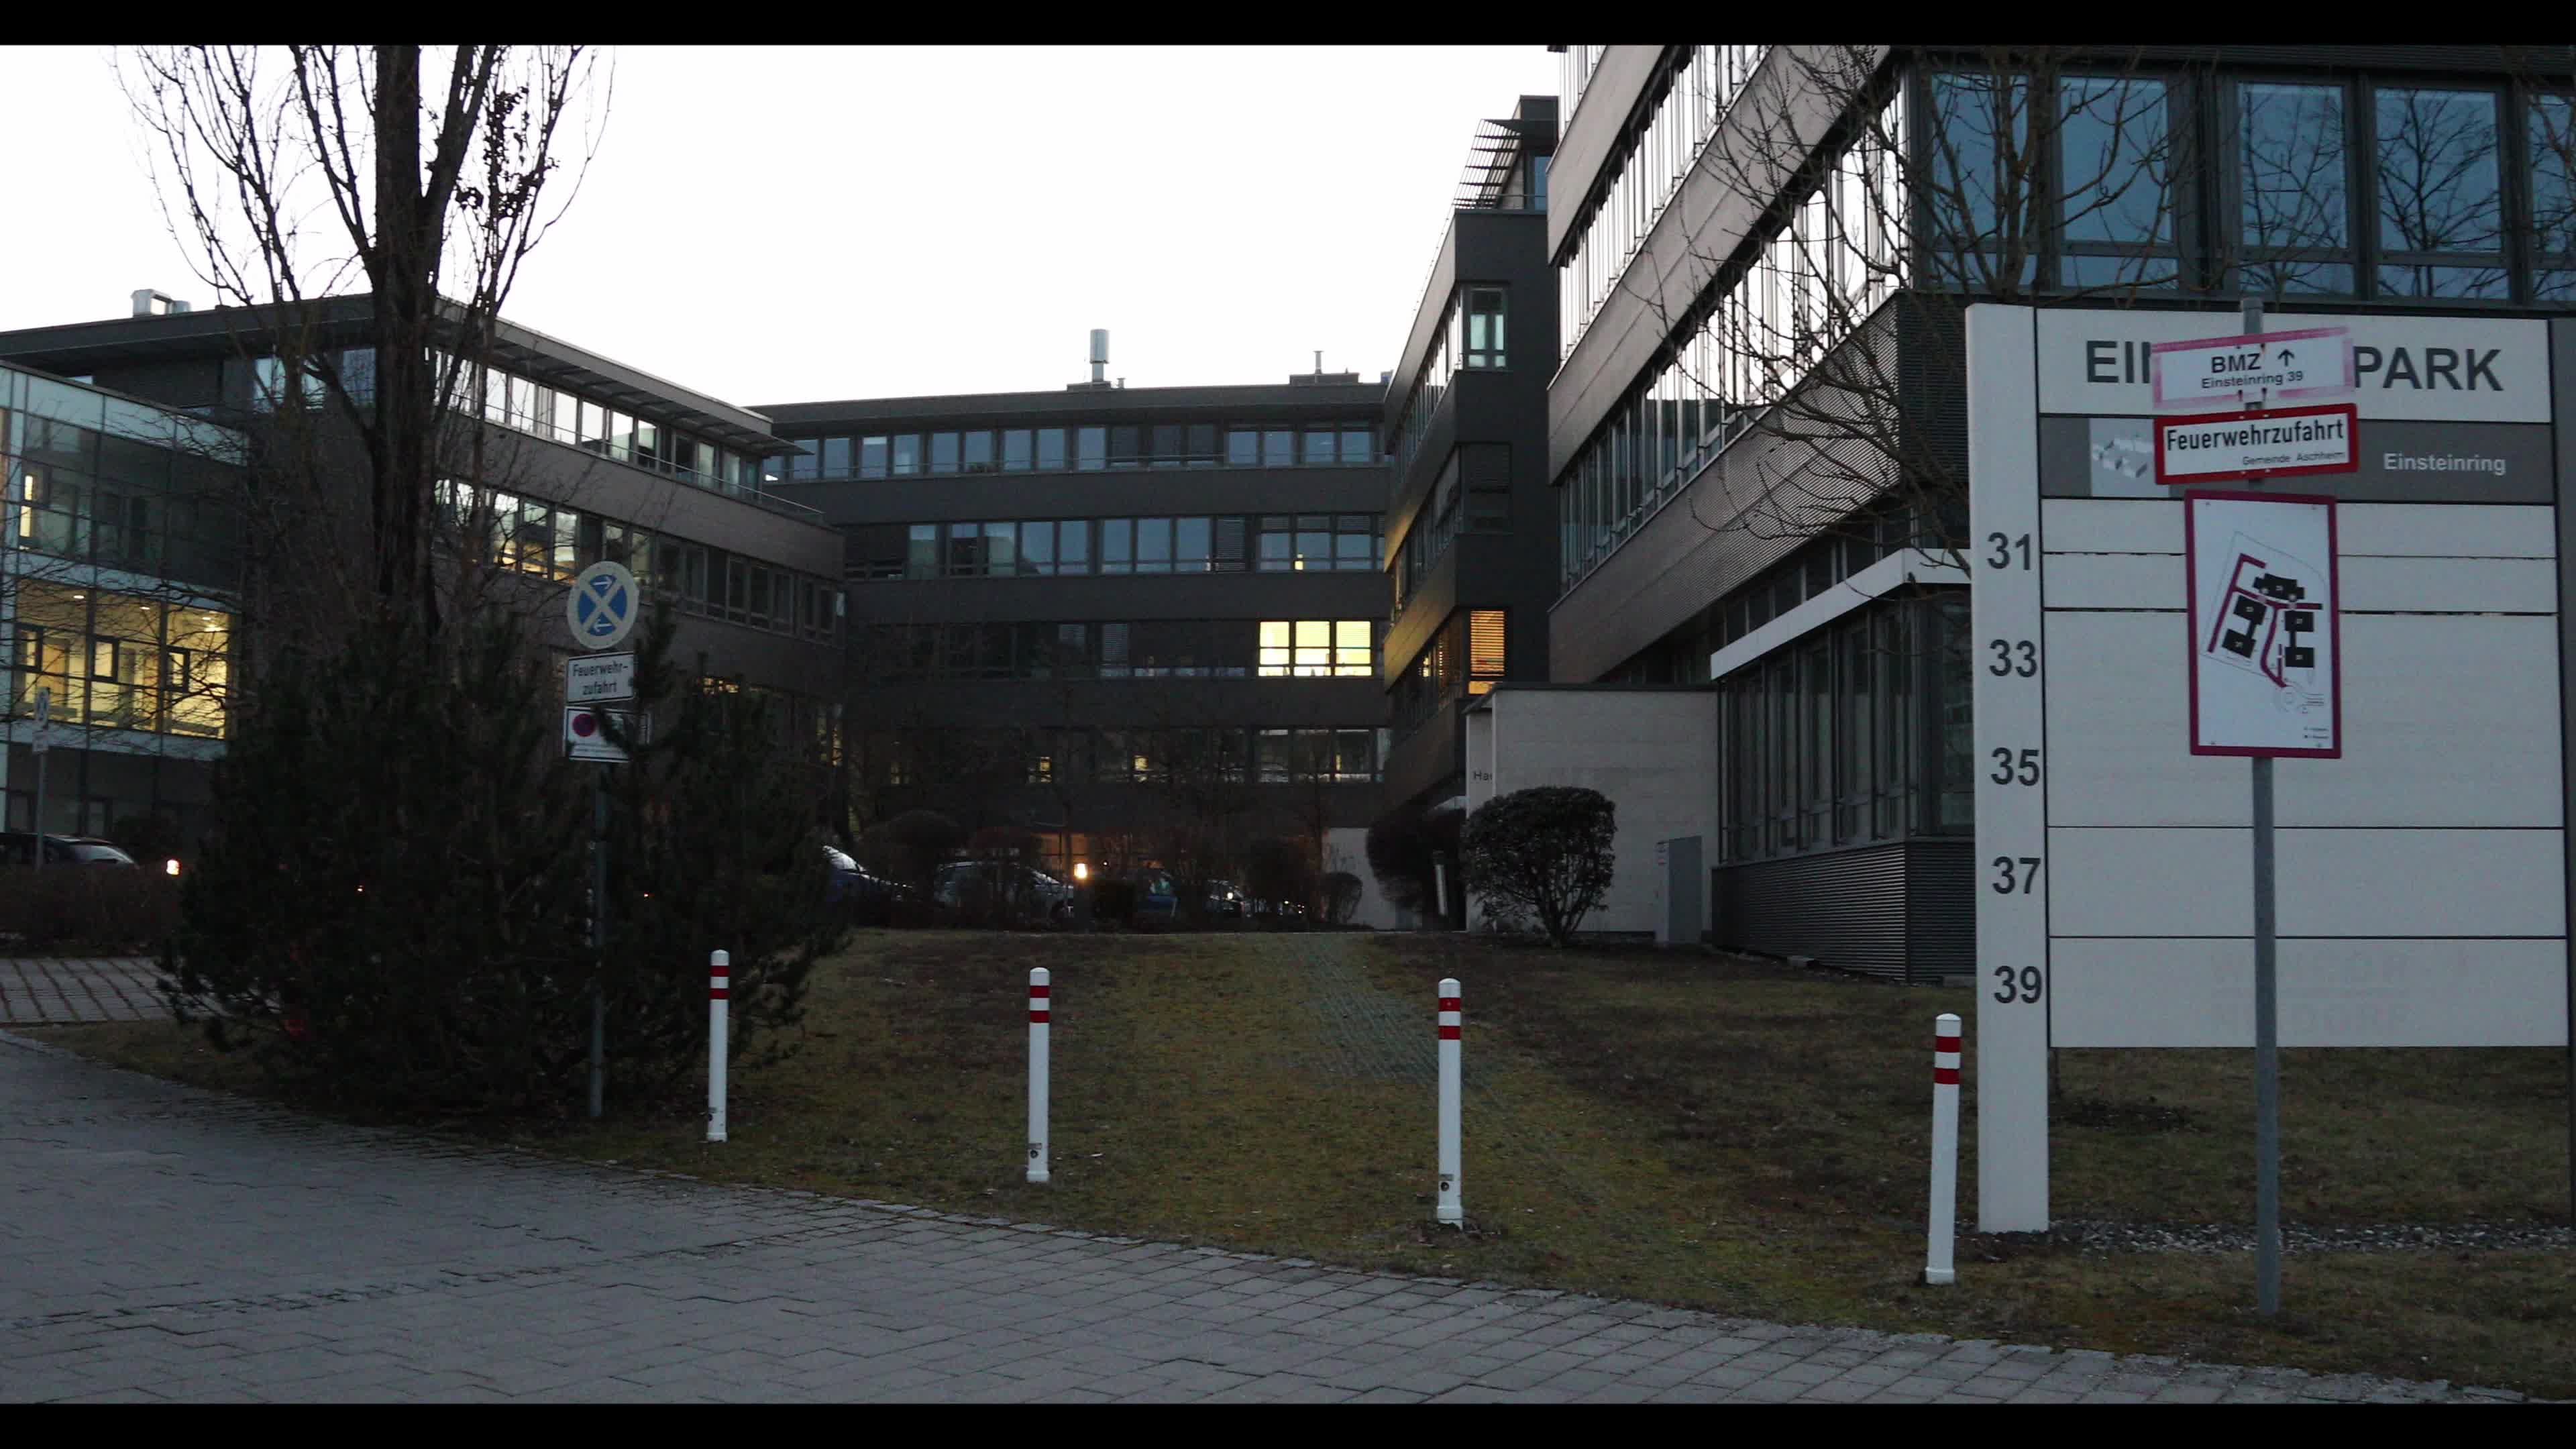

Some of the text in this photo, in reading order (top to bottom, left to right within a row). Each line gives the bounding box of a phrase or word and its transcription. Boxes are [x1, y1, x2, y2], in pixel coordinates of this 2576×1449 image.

[2201, 371, 2304, 389] Einsteinring 39
[2211, 354, 2261, 373] BMZ
[2353, 346, 2504, 391] PARK
[2166, 419, 2344, 451] Feuerwehrzufahrt
[2383, 453, 2506, 476] Einsteinring
[1987, 532, 2032, 570] 31
[573, 661, 629, 677] Feuerwehr-
[1990, 639, 2038, 678] 33
[582, 680, 618, 695] zufahrt
[1990, 747, 2040, 786] 35
[1992, 856, 2041, 894] 37
[1993, 966, 2043, 1004] 39
